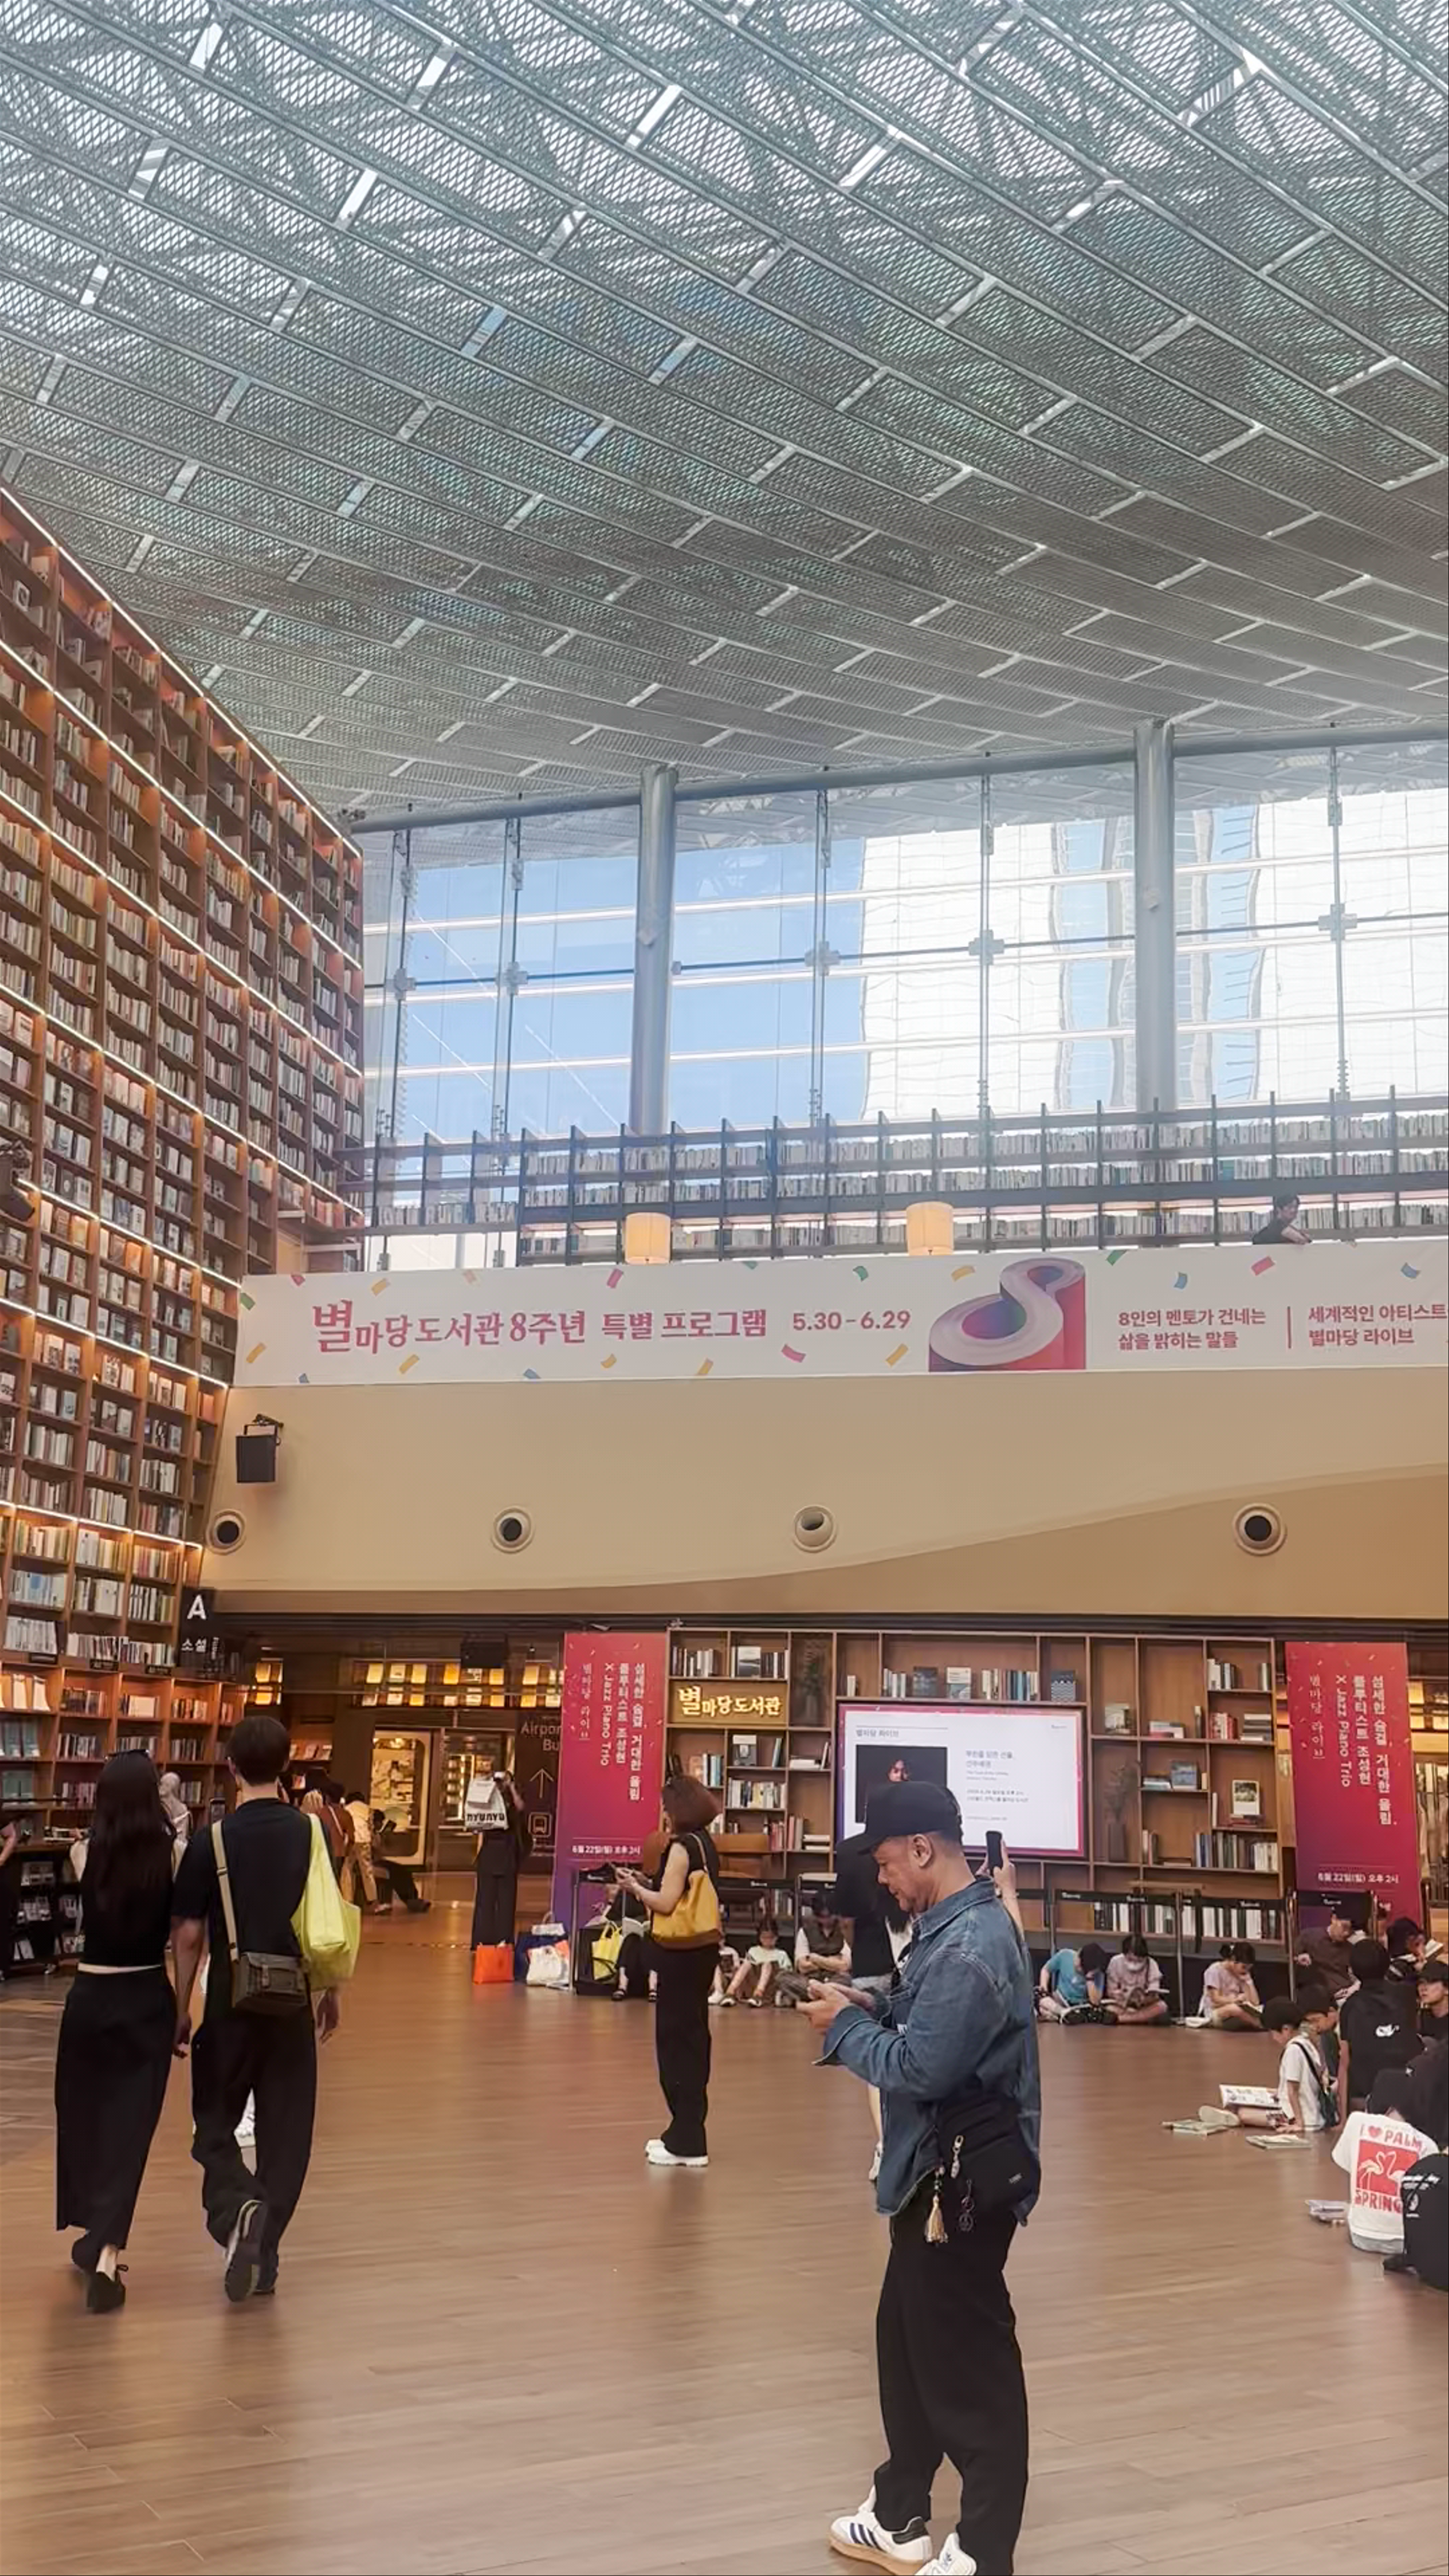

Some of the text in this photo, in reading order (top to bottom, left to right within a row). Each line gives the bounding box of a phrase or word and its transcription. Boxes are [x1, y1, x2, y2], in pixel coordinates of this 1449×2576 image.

[1119, 1308, 1266, 1327] 8인의 멘토가 건네는
[1309, 1305, 1374, 1322] 세계적인
[510, 1311, 585, 1345] 8주년
[602, 1312, 652, 1340] 특별
[661, 1310, 766, 1337] 프로그램
[1309, 1328, 1415, 1346] 별마당 라이브
[1119, 1331, 1238, 1350] 삶을 밝히는 말들
[187, 1595, 206, 1619] A
[181, 1638, 206, 1652] 소설
[1337, 1688, 1347, 1717] Jazz
[521, 1721, 561, 1738] Airpor
[601, 1705, 612, 1738] Piano
[543, 1738, 560, 1751] Bu
[1338, 1721, 1349, 1757] Piano
[600, 1742, 611, 1766] Trio
[1341, 1761, 1352, 1787] Trio
[1355, 2190, 1401, 2213] SPRING
